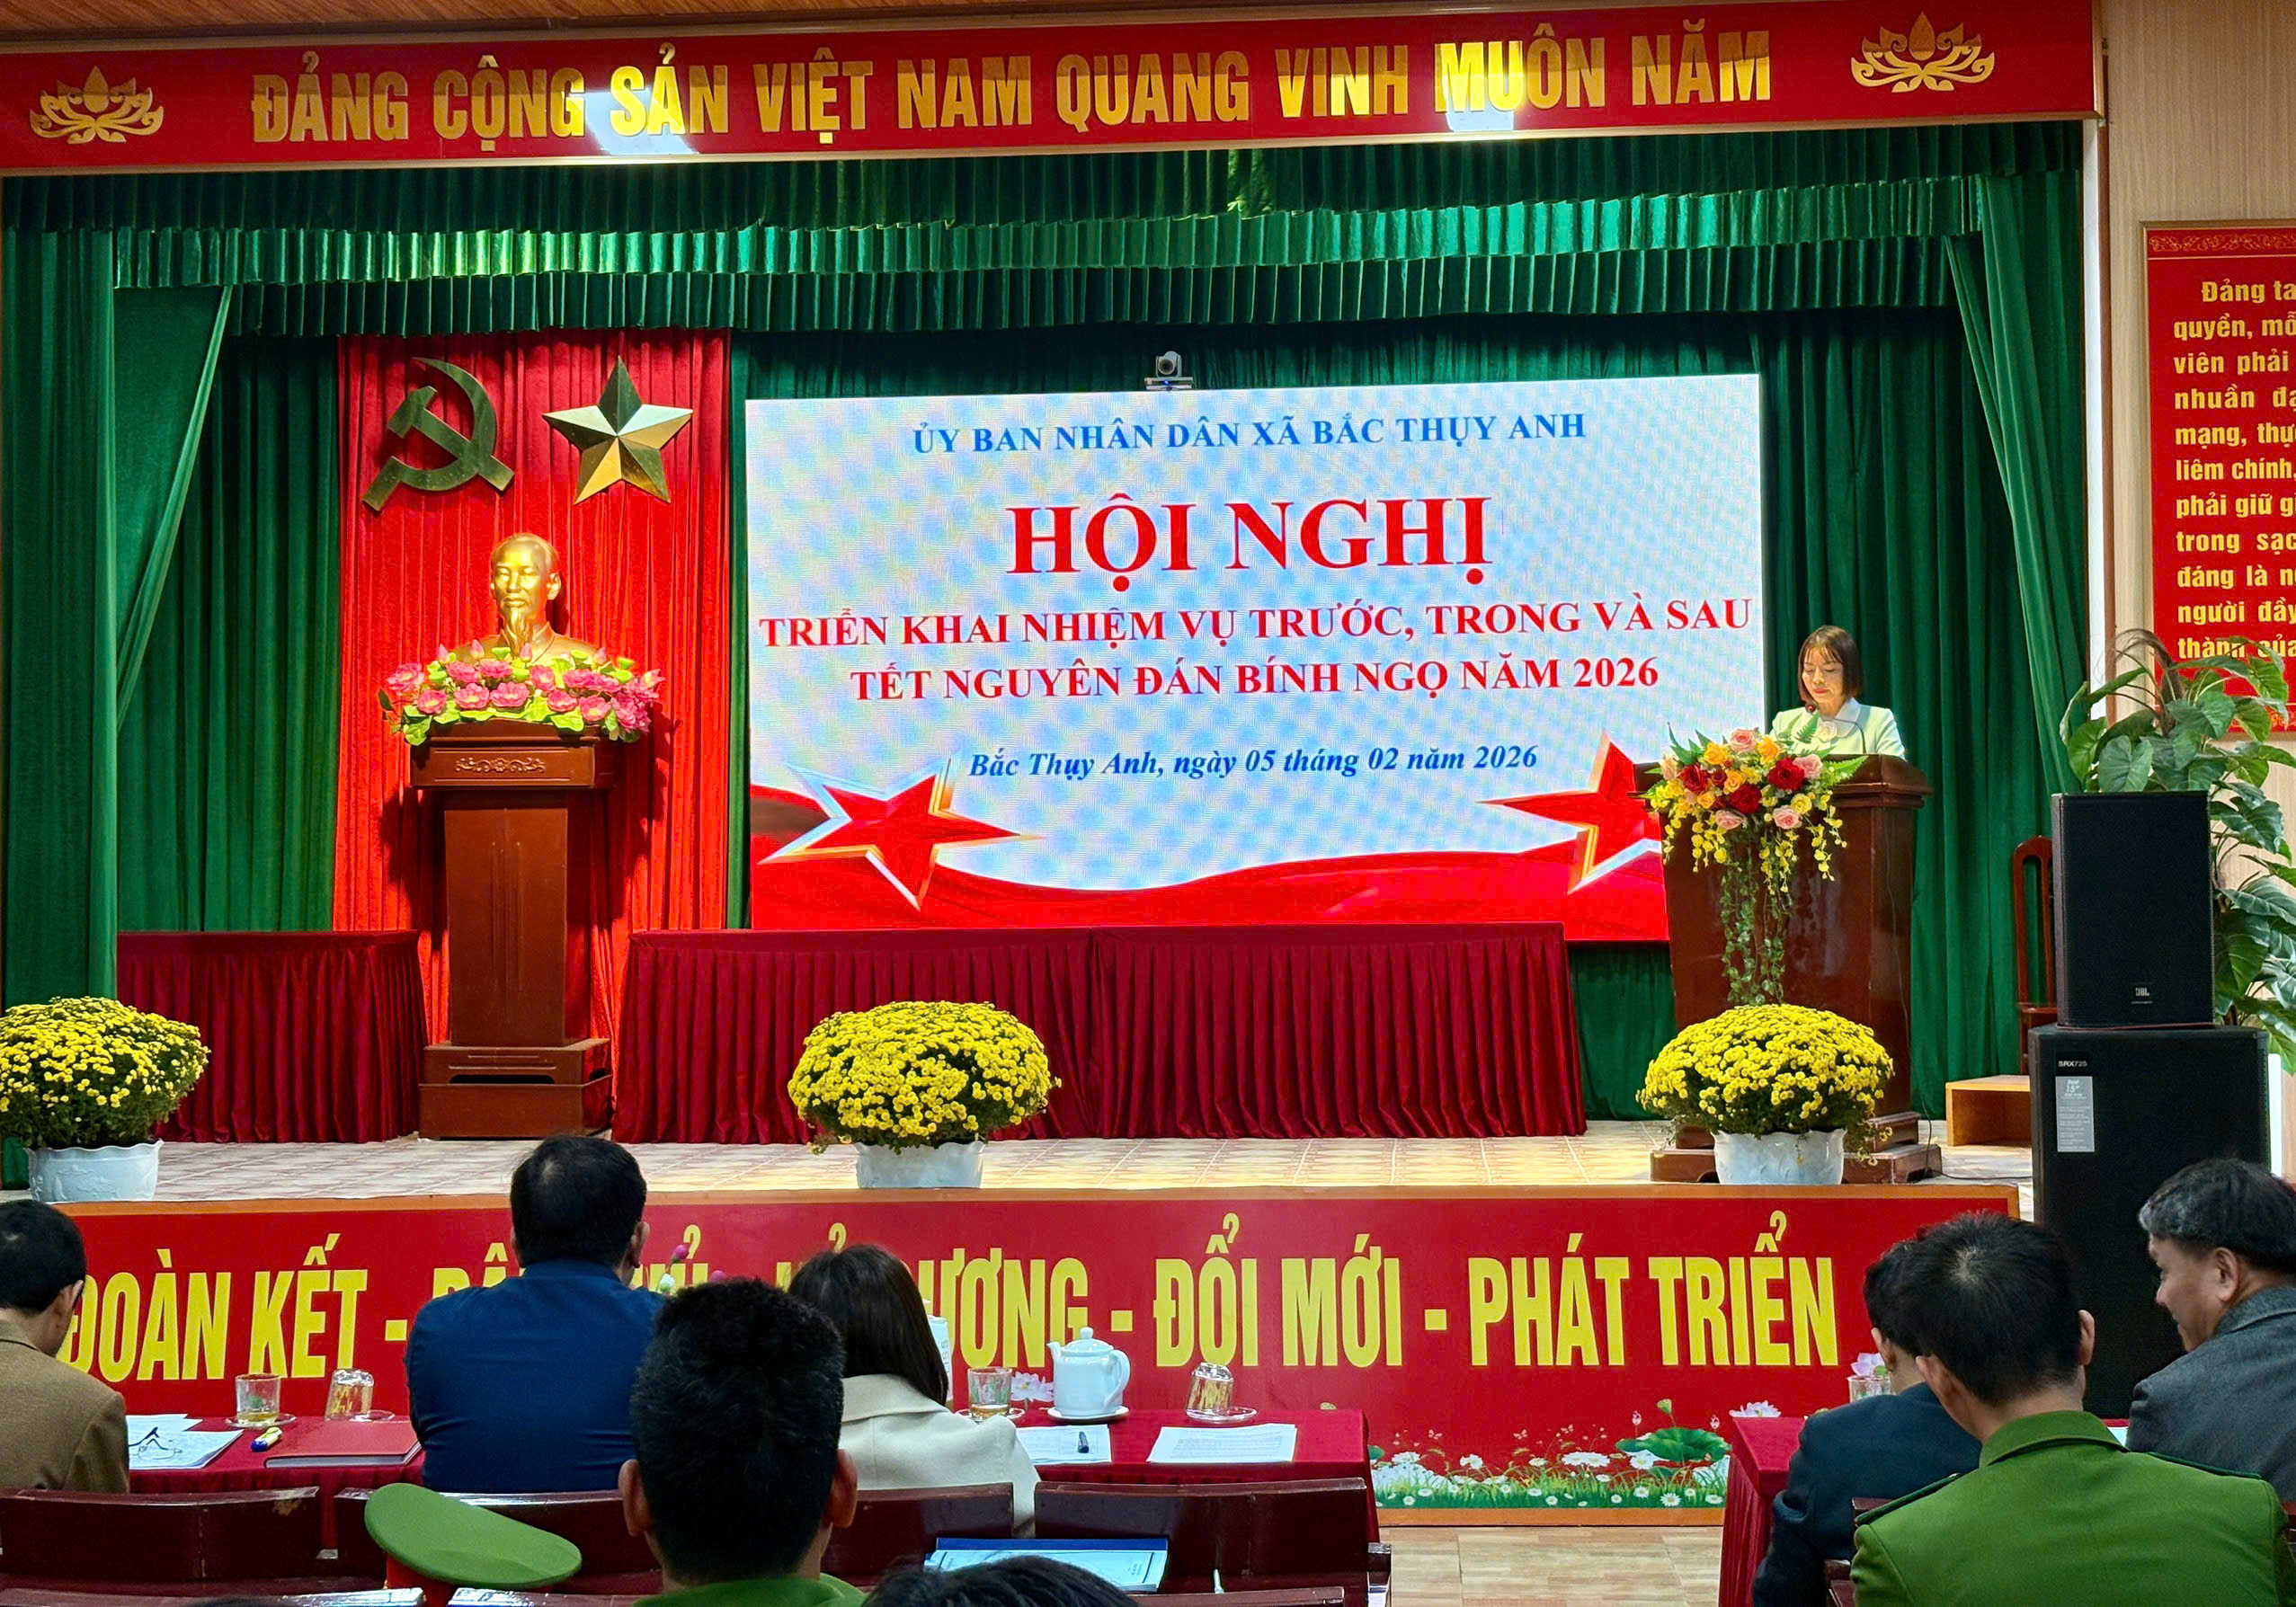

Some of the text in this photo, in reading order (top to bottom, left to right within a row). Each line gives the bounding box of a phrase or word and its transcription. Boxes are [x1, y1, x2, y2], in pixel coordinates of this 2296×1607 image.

[251, 18, 1772, 152] ĐẢNG CỘNG SẢN VIỆT NAM QUANG VINH MUÔN NĂM
[2201, 278, 2296, 304] Đảng ta
[2174, 312, 2253, 342] quyền,
[2173, 348, 2289, 375] viên phải
[2175, 383, 2256, 410] nhuần
[912, 413, 1587, 454] ỦY BAN NHÂN DÂN XÃ BẮC THỤY ANH
[2175, 422, 2296, 449] mạng, thự
[2176, 459, 2224, 481] liêm
[2176, 491, 2227, 519] phải
[2235, 493, 2274, 519] giữ
[1005, 492, 1493, 592] HỘI NGHỊ
[2176, 531, 2240, 555] trong
[2176, 564, 2296, 590] đáng là n
[901, 614, 1010, 646] KHAI
[1021, 608, 1165, 649] NHIỆM
[1179, 609, 1238, 647] VỤ
[1254, 597, 1415, 642] TRƯỚC,
[1425, 603, 1581, 635] TRONG
[1594, 592, 1654, 631] VÀ
[1667, 599, 1752, 630] SAU
[2177, 600, 2246, 626] người
[850, 653, 1659, 701] TẾT NGUYÊN ĐÁN BÍNH NGỌ NĂM 2026
[968, 745, 1537, 781] Bắc Thụy Anh, ngày 05 tháng 02 năm 2026
[2135, 987, 2150, 997] JBL
[245, 1232, 369, 1381] KẾT
[384, 1318, 408, 1342] -
[917, 1247, 1090, 1371] ƯƠNG
[1110, 1310, 1134, 1333] -
[1152, 1212, 1259, 1368] ĐỔI
[1280, 1233, 1403, 1369] MỚI
[1424, 1309, 1447, 1331] -
[1467, 1232, 1631, 1367] PHÁT
[1648, 1210, 1839, 1367] TRIỂN
